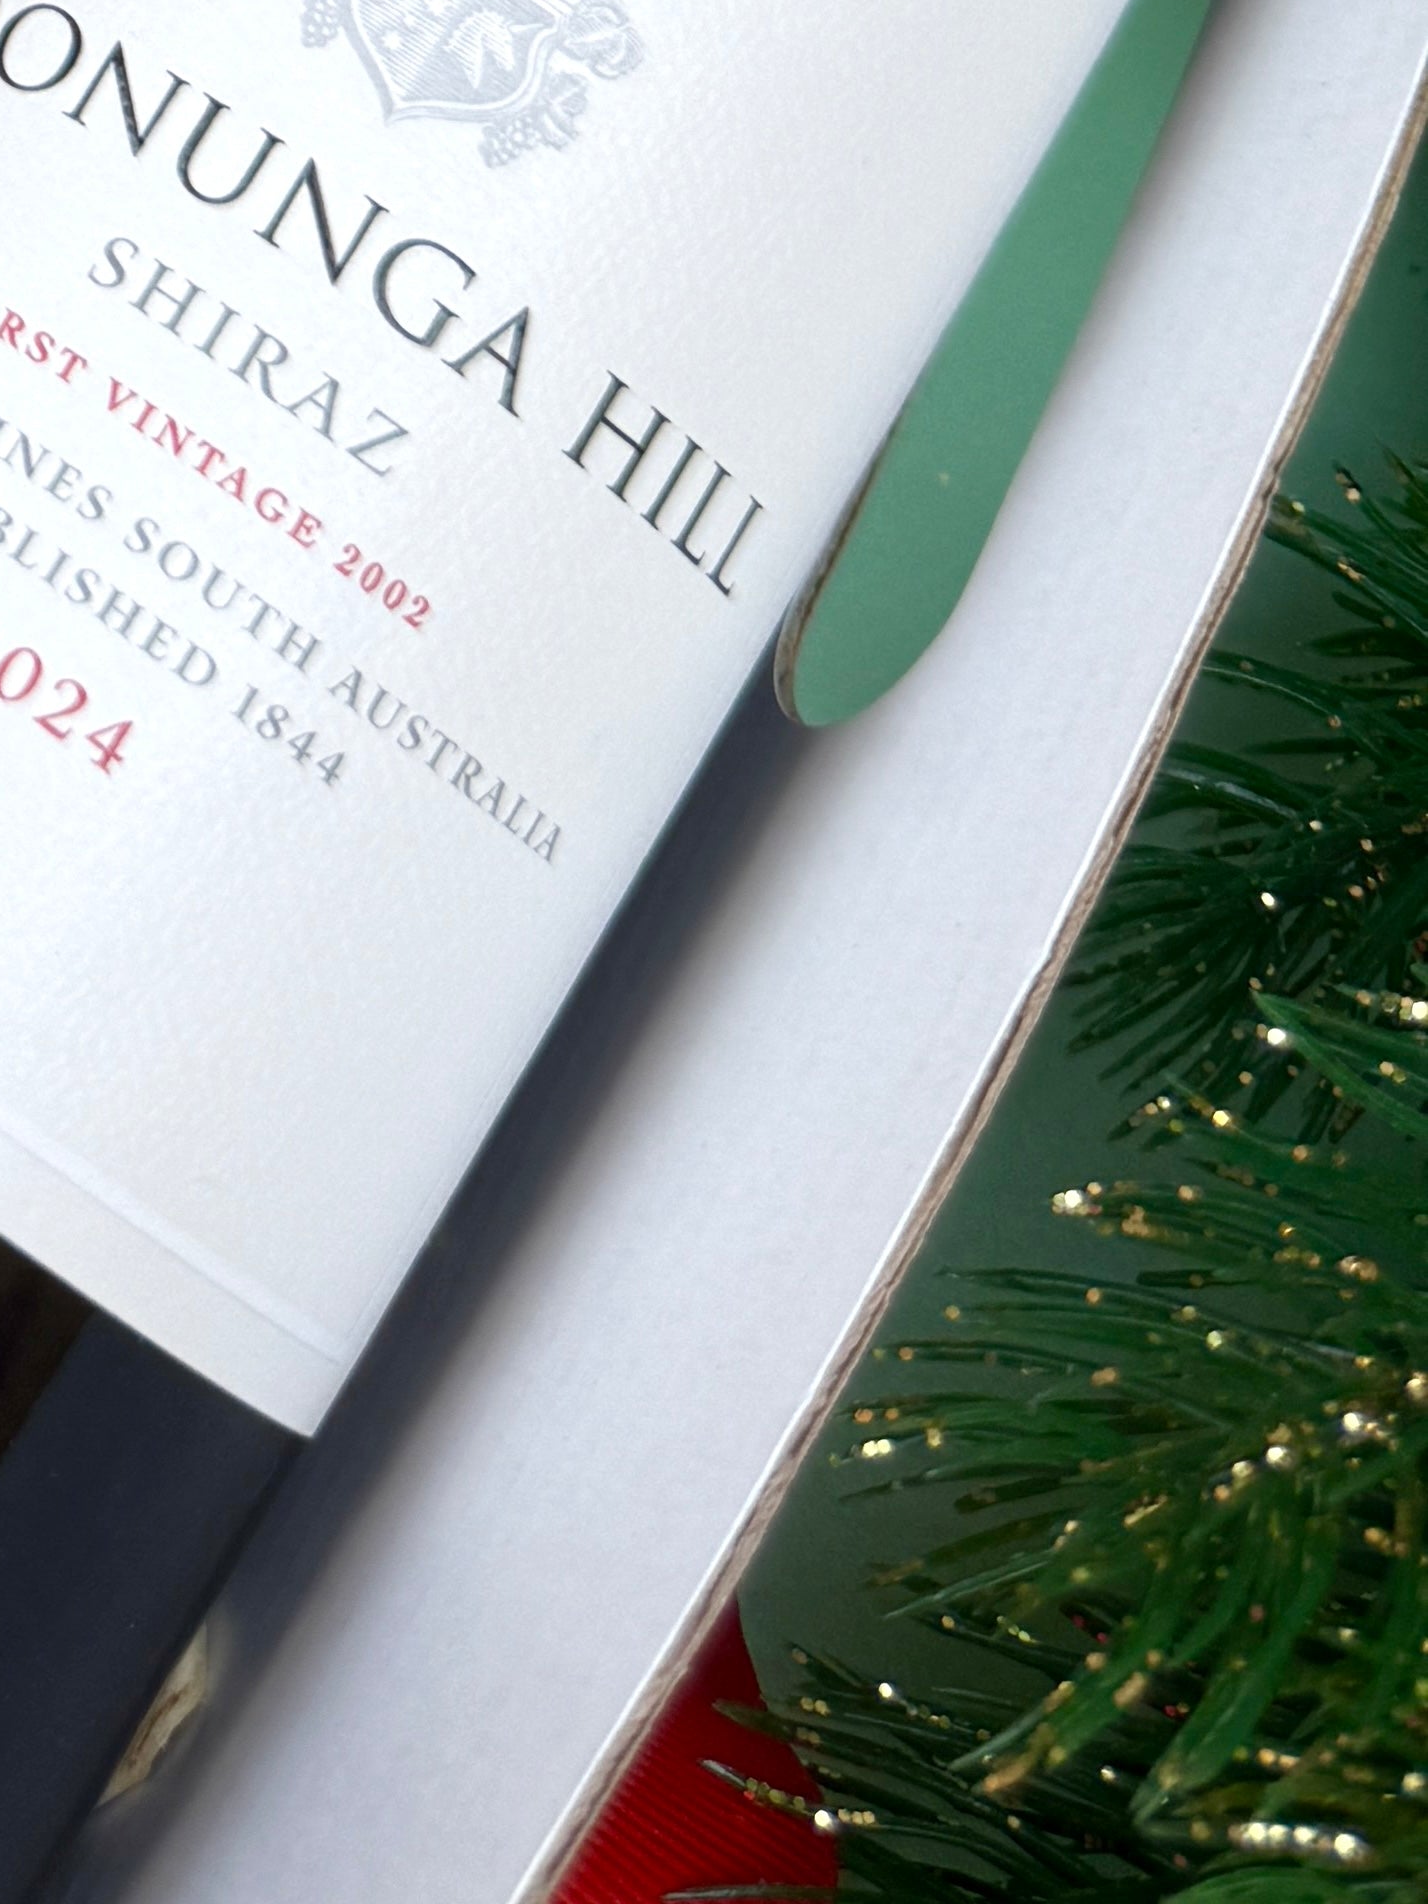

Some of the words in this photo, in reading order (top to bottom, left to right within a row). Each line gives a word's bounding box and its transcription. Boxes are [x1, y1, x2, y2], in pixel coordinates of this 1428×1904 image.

[86, 237, 411, 480] SHIRAZ
[108, 377, 323, 548] VINTAGE
[334, 542, 431, 631] 2002
[561, 370, 764, 597] HILL
[124, 517, 322, 673] SOUTH
[330, 664, 564, 864] AUSTRALIA
[230, 683, 349, 788] 1844
